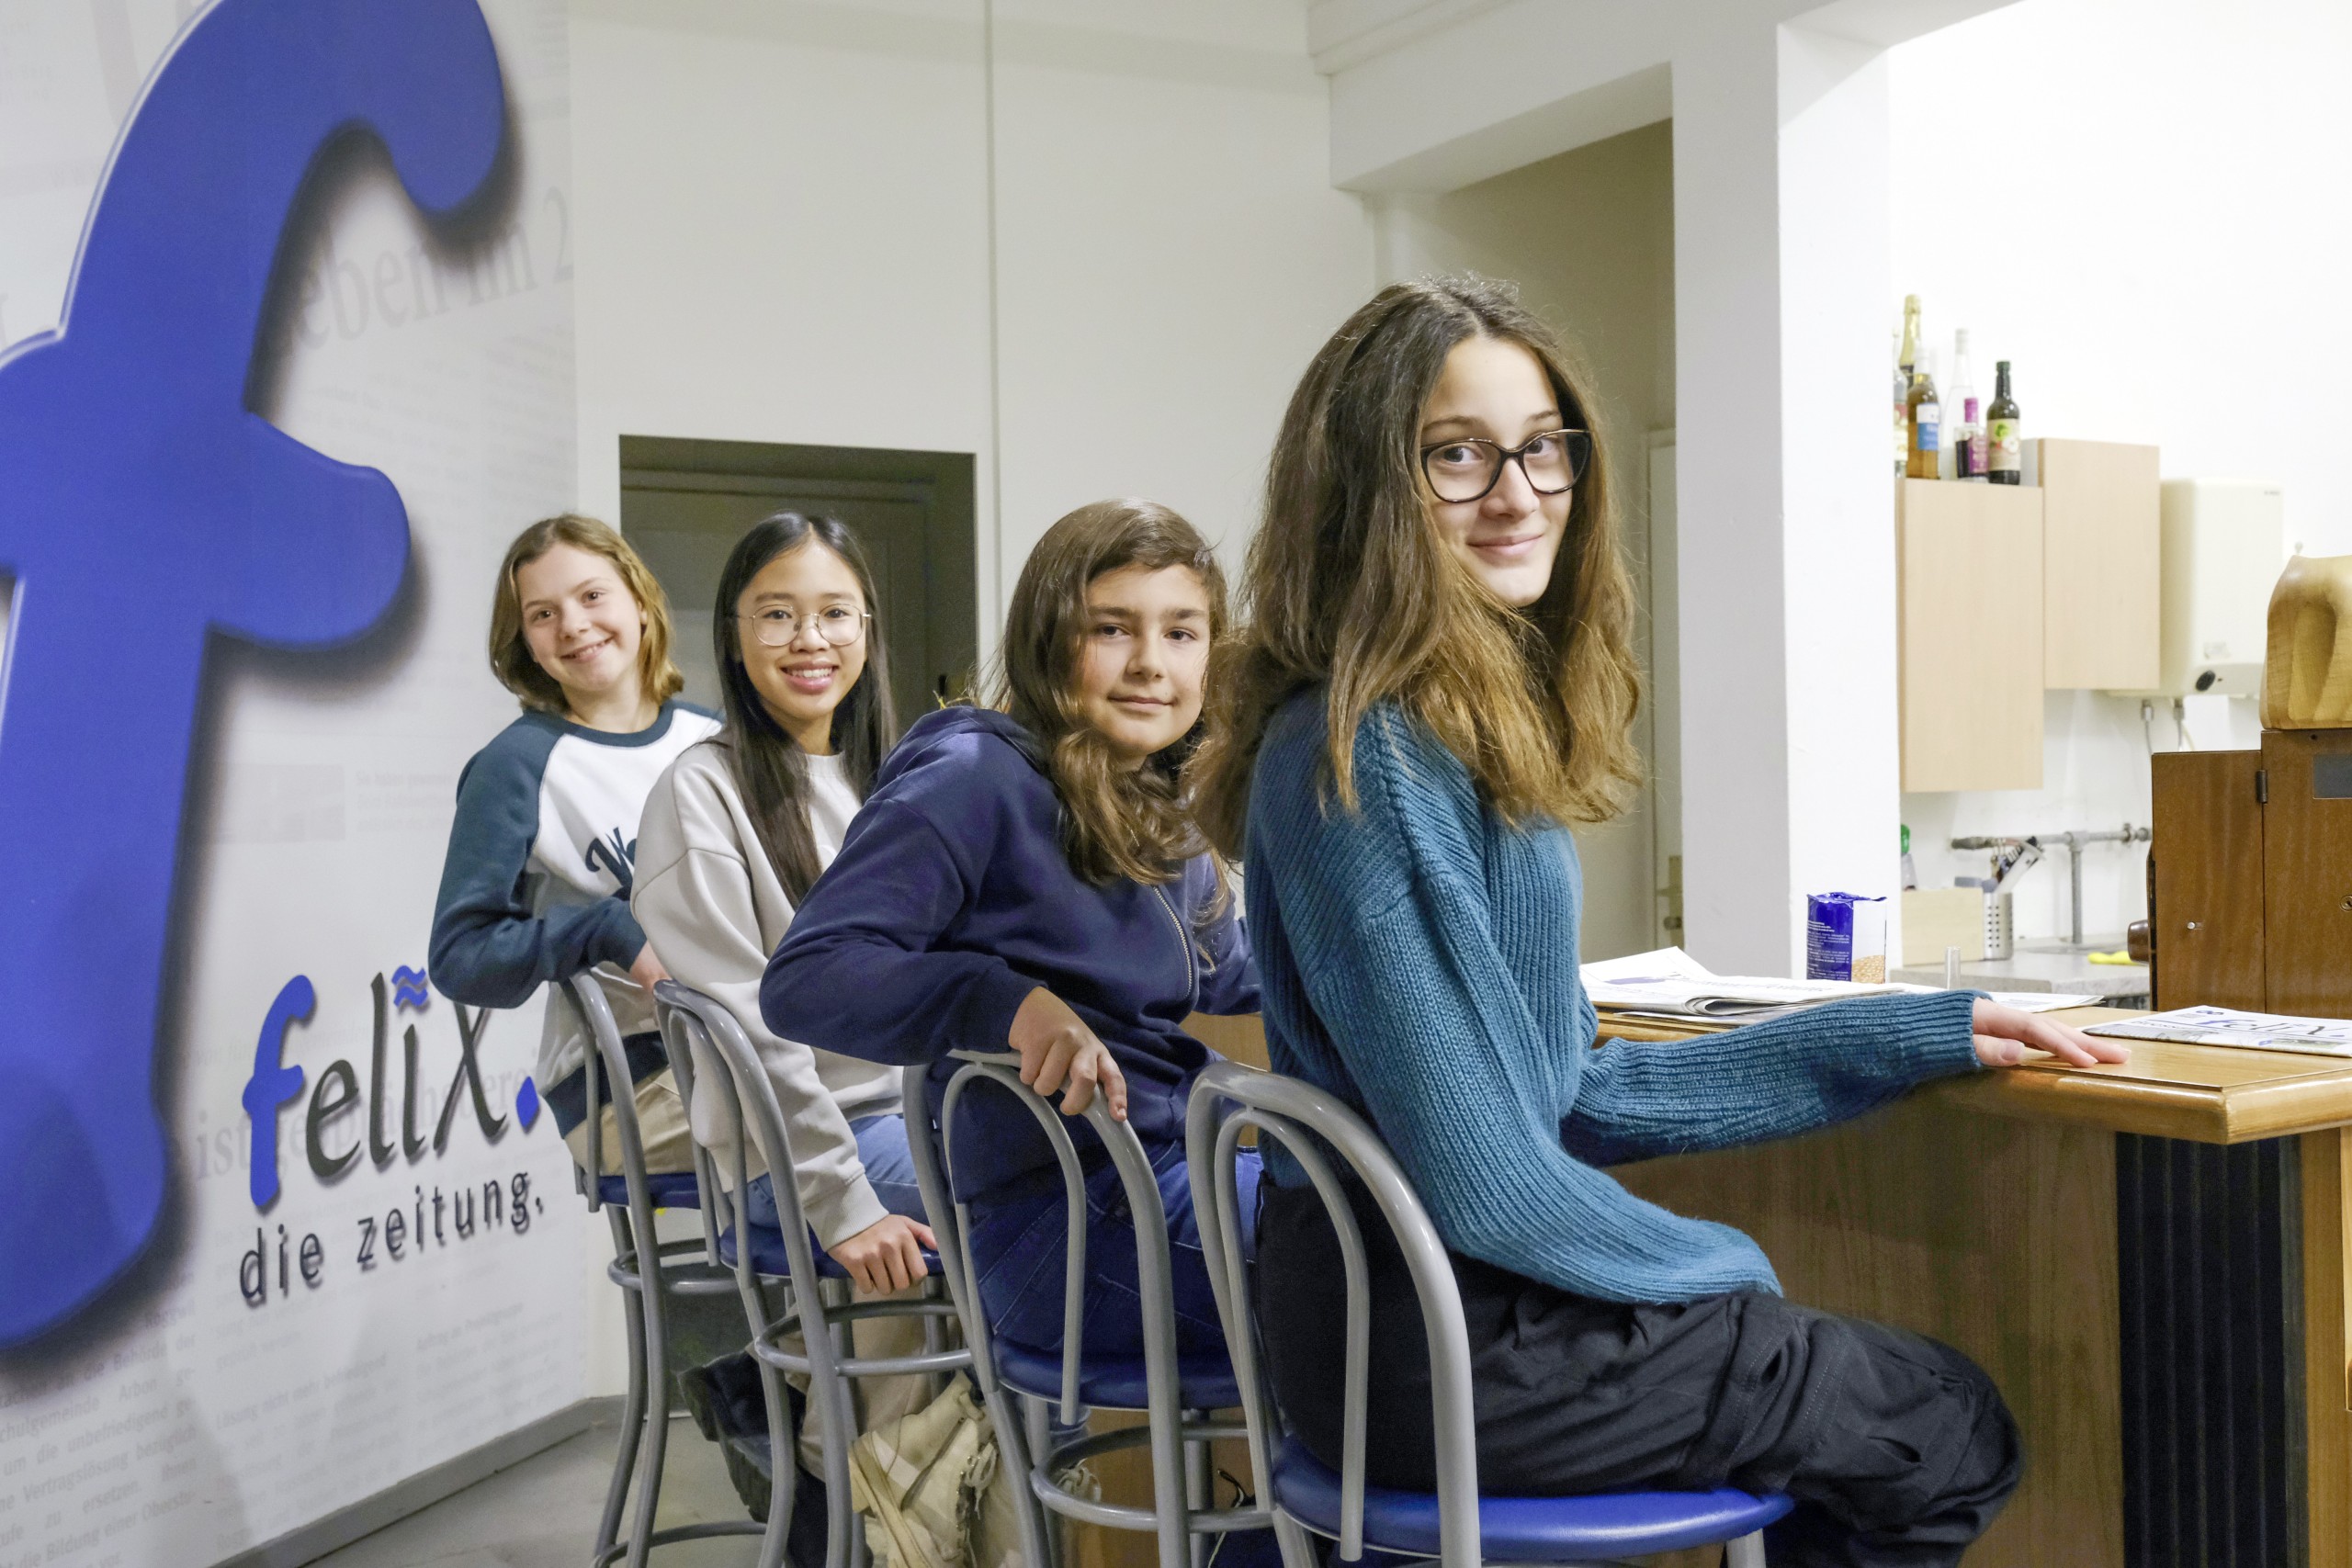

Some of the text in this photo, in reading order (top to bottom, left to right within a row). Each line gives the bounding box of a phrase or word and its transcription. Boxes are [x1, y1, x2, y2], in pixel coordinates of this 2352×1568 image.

[240, 1224, 322, 1299] die
[357, 1172, 541, 1264] zeitung.
[0, 1394, 100, 1443] chulgemeinde
[119, 1376, 157, 1402] Arbon
[37, 1442, 60, 1464] die
[68, 1404, 168, 1453] unbefriedigend
[23, 1450, 129, 1503] Vertragslösung
[45, 1510, 62, 1529] zu
[47, 1527, 100, 1562] Bildung
[104, 1511, 139, 1539] einer
